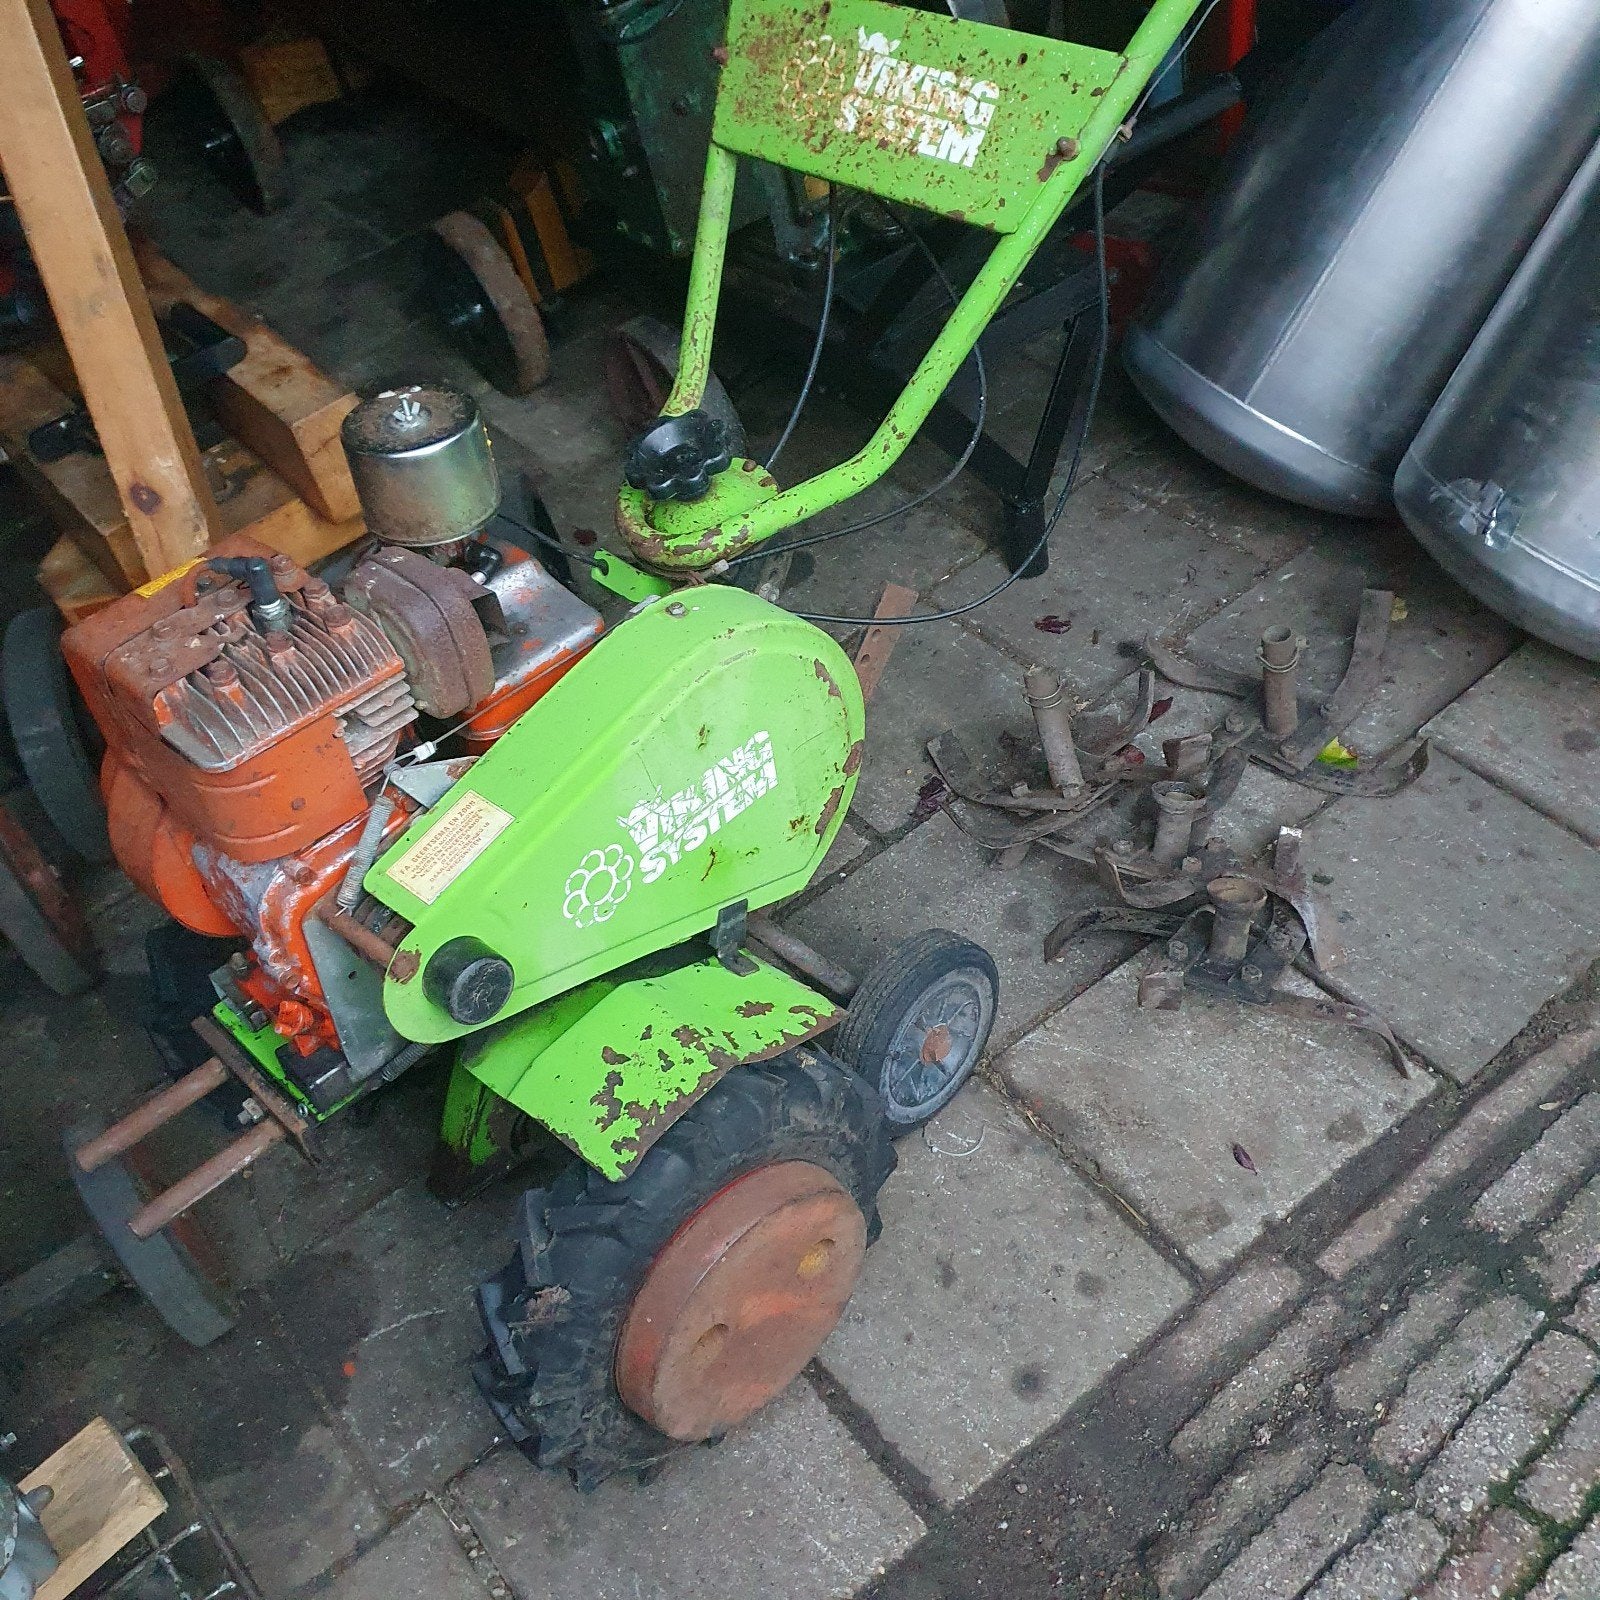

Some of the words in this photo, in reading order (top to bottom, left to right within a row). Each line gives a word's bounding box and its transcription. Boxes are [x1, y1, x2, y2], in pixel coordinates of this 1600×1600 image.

[853, 50, 1000, 128] VIKING
[410, 824, 450, 863] GEERTSEMA
[447, 815, 459, 826] EN
[456, 799, 476, 817] ZOON
[628, 730, 773, 854] VIKING
[639, 757, 778, 884] SYSTEM
